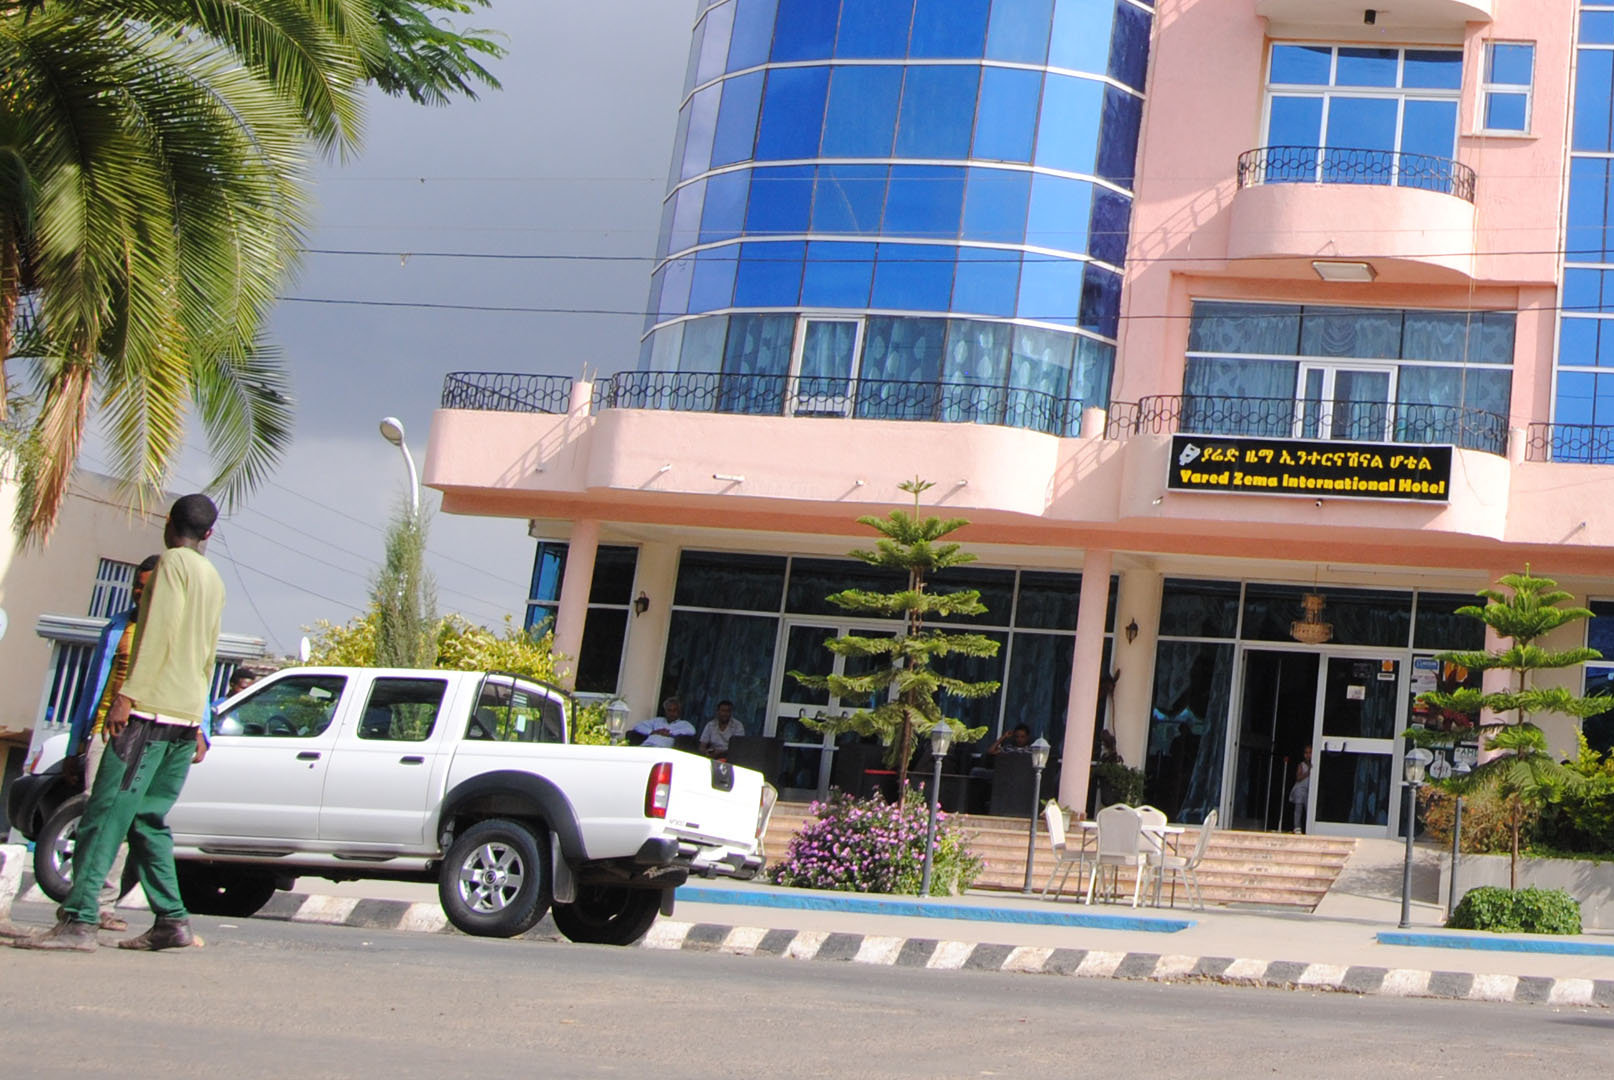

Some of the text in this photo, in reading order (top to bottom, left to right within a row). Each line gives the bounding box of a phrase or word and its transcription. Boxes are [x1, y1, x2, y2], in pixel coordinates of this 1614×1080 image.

[1200, 447, 1432, 471] ያሬድ ዜማ ኢንተርናሽናል ሆቴል
[1179, 469, 1446, 495] Yared Zema International Hotel
